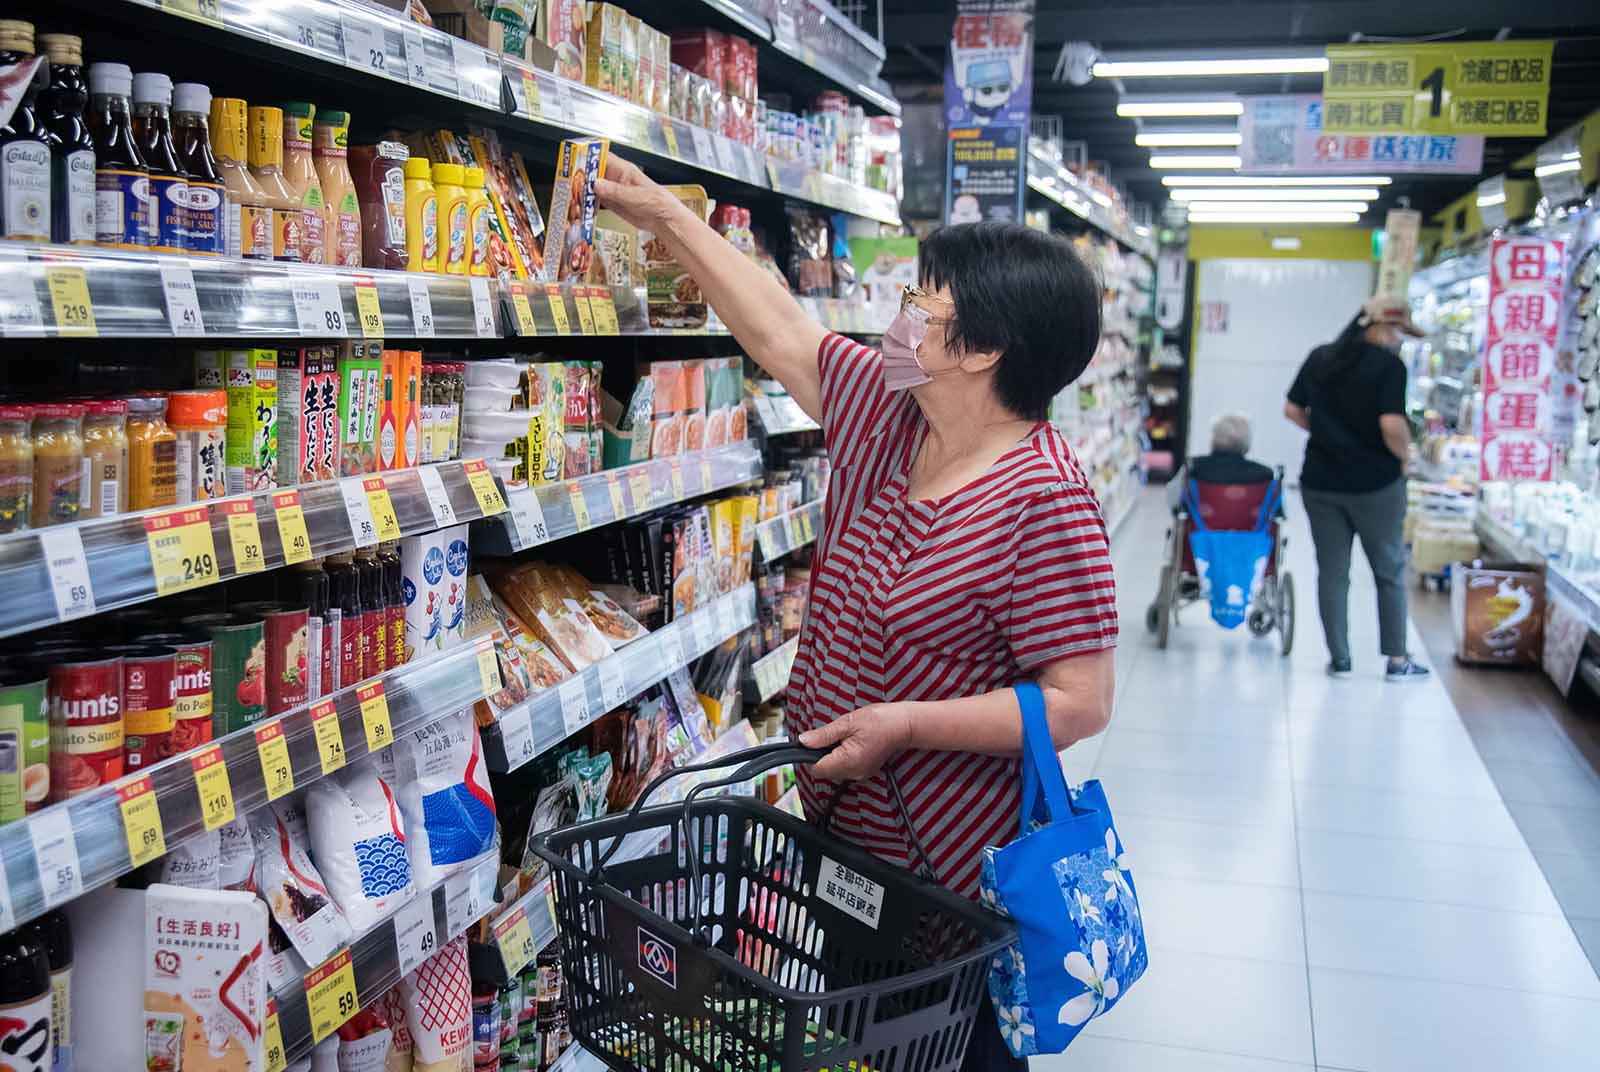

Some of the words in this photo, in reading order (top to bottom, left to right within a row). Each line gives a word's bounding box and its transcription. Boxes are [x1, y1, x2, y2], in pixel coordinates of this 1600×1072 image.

[369, 49, 385, 70] 22
[1460, 58, 1544, 83] 冷藏日配品
[1420, 66, 1446, 118] 1
[1327, 101, 1405, 128] 南北貨
[1456, 99, 1540, 125] 冷藏日配品
[62, 304, 89, 321] 219
[183, 308, 197, 322] 41
[325, 310, 342, 331] 89
[364, 314, 379, 327] 109
[1497, 244, 1547, 479] 母親節蛋糕
[304, 378, 321, 473] 生にんにく
[321, 375, 337, 468] 生にんにく
[360, 521, 371, 534] 56
[384, 515, 394, 529] 34
[535, 524, 545, 539] 35
[293, 535, 305, 548] 40
[244, 545, 259, 559] 92
[182, 553, 213, 580] 249
[71, 584, 87, 602] 69
[88, 728, 120, 743] Sauce
[374, 724, 385, 737] 99
[329, 742, 341, 760] 74
[522, 740, 534, 756] 43
[275, 766, 287, 782] 79
[208, 794, 228, 814] 110
[143, 827, 157, 845] 69
[57, 866, 74, 884] 55
[420, 931, 434, 952] 49
[338, 991, 354, 1016] 59
[440, 1023, 470, 1047] KEWP
[267, 1046, 280, 1064] 99
